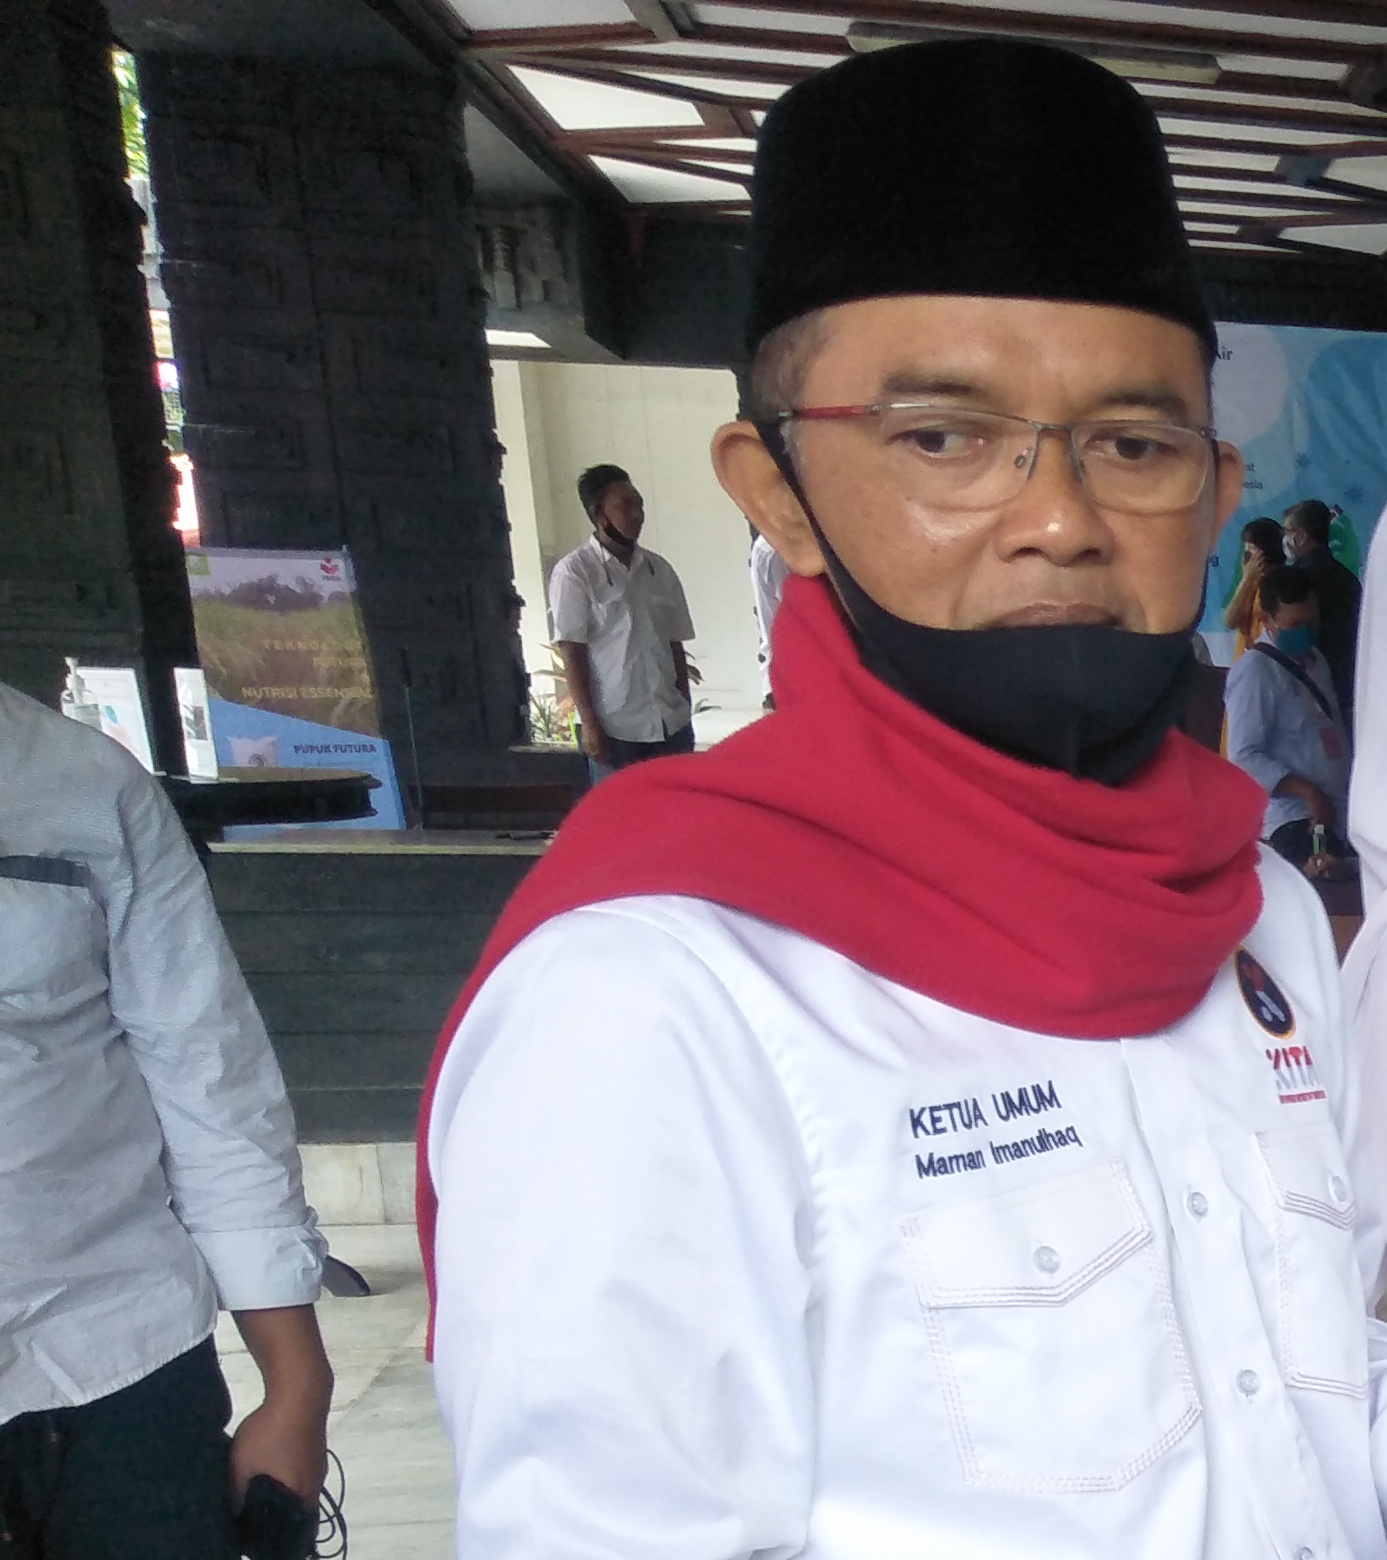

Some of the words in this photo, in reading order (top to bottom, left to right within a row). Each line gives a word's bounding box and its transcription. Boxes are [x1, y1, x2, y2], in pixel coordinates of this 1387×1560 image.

[293, 743, 332, 754] PUPUK
[333, 743, 377, 754] FUTURA
[909, 1097, 989, 1139] KETUA
[991, 1079, 1063, 1122] UMUM
[915, 1149, 987, 1179] Maman
[989, 1125, 1084, 1165] Imanulhaq
